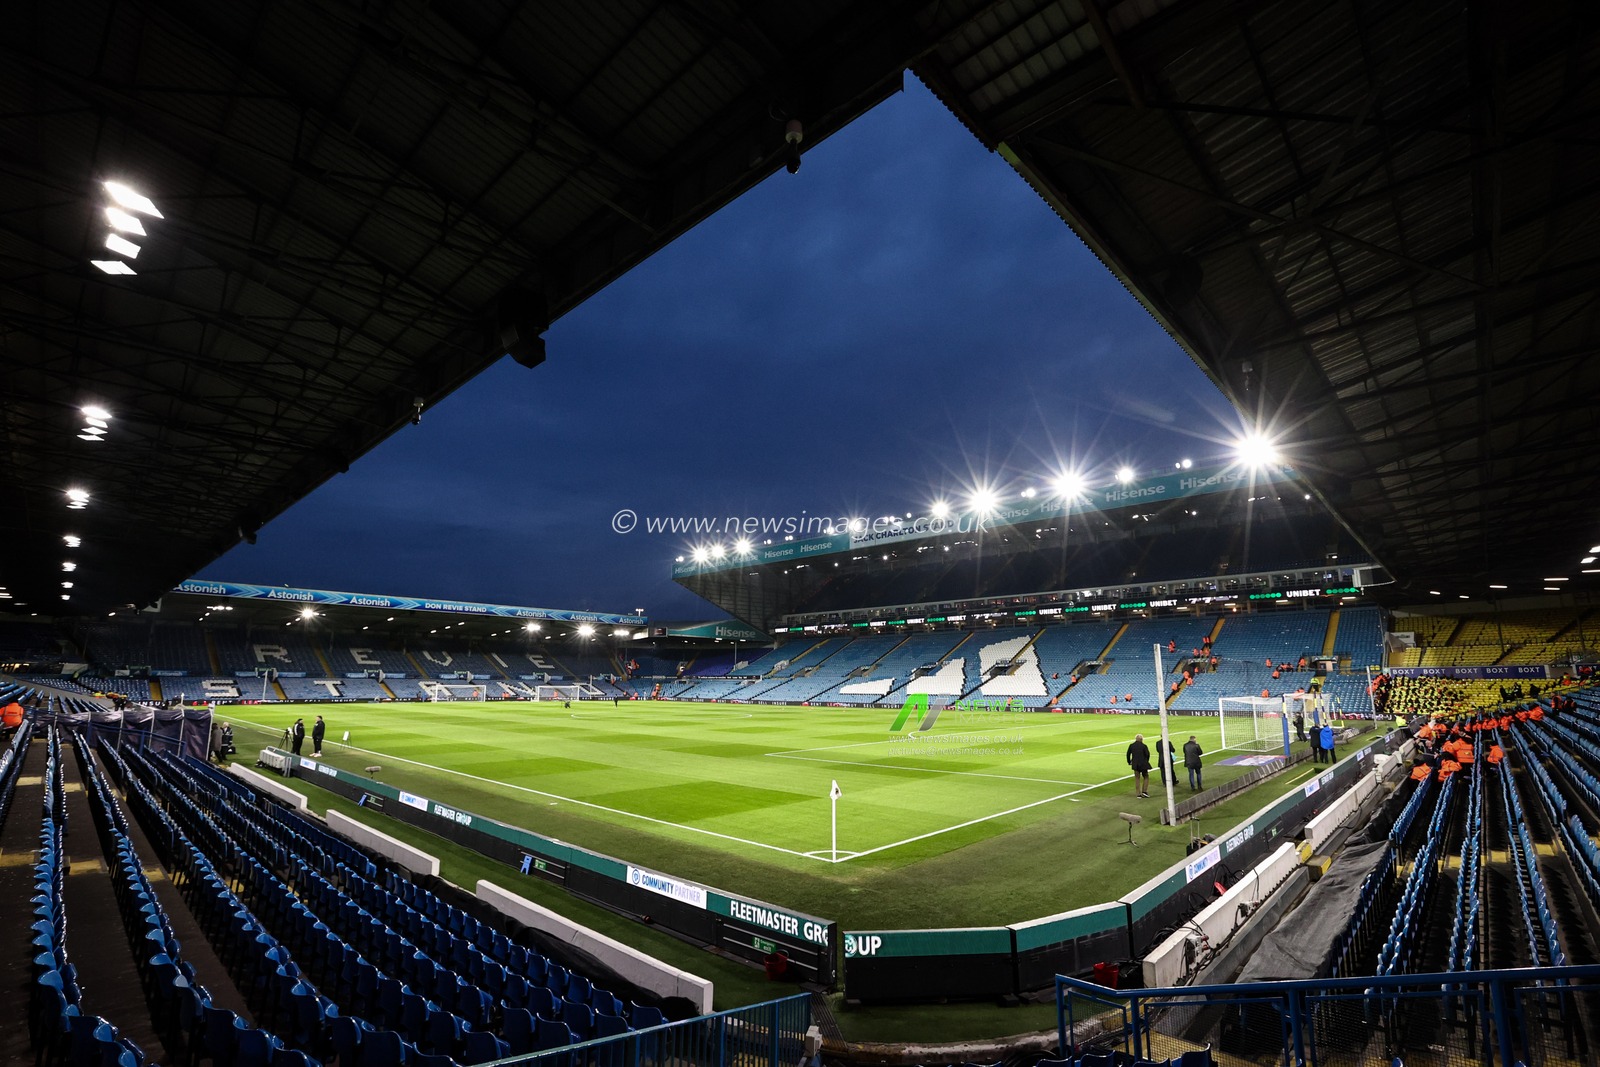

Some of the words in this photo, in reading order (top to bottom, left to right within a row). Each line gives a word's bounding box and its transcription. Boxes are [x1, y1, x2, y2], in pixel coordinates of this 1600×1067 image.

[1180, 471, 1246, 490] Hisense
[1105, 484, 1165, 502] Hisense
[853, 533, 874, 543] JACK
[875, 525, 920, 539] CHARLTON
[764, 547, 793, 559] Hisense
[800, 541, 832, 553] Hisense
[267, 589, 314, 601] Astonish
[1286, 588, 1321, 598] UNIBET
[349, 596, 391, 607] Astonish
[425, 602, 441, 610] DON
[464, 605, 487, 613] STAND
[1091, 603, 1117, 612] UNIBET
[1150, 599, 1178, 607] UNIBET
[516, 610, 547, 618] Astonish
[570, 614, 598, 622] Astonish
[619, 617, 644, 625] Astonish
[715, 626, 756, 638] Hisense
[641, 874, 675, 894] COMMUNITY
[674, 884, 701, 903] PARTNER
[730, 900, 799, 936] FLEETMASTER
